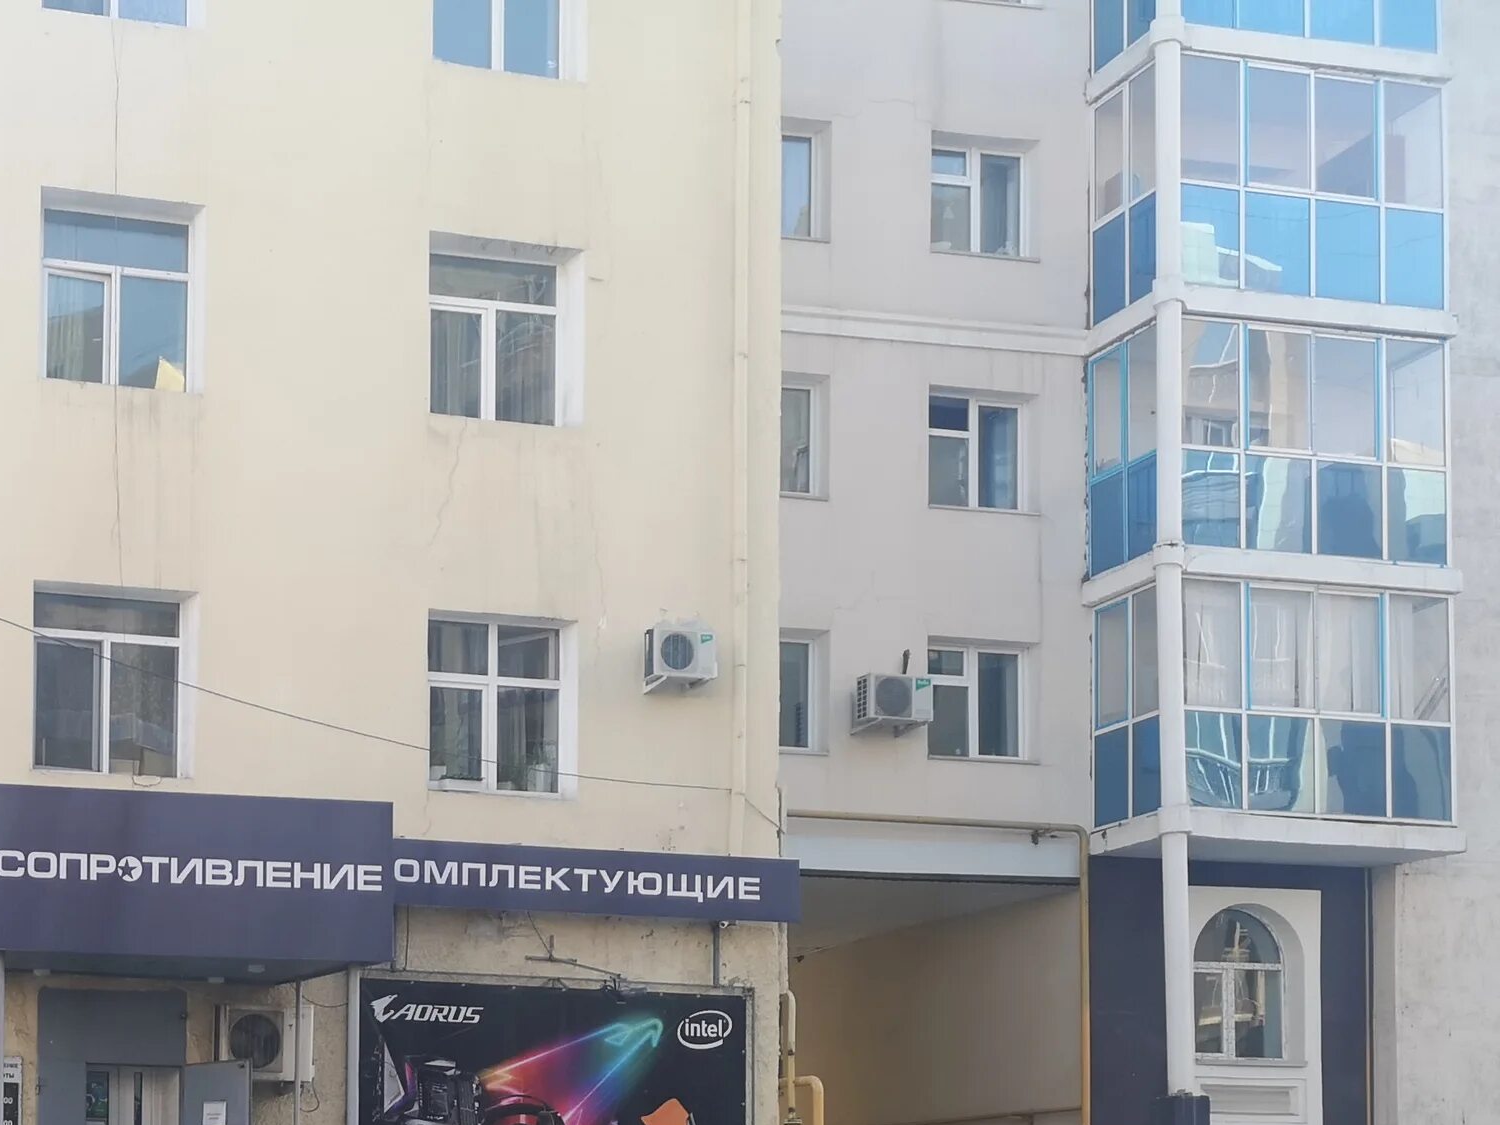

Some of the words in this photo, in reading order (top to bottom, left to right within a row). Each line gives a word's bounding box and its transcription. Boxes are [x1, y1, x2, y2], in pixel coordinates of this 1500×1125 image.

[393, 857, 762, 903] ОМПЛЕКТУЮЩИЕ
[391, 1003, 485, 1025] AORUS
[683, 1018, 723, 1038] intel
